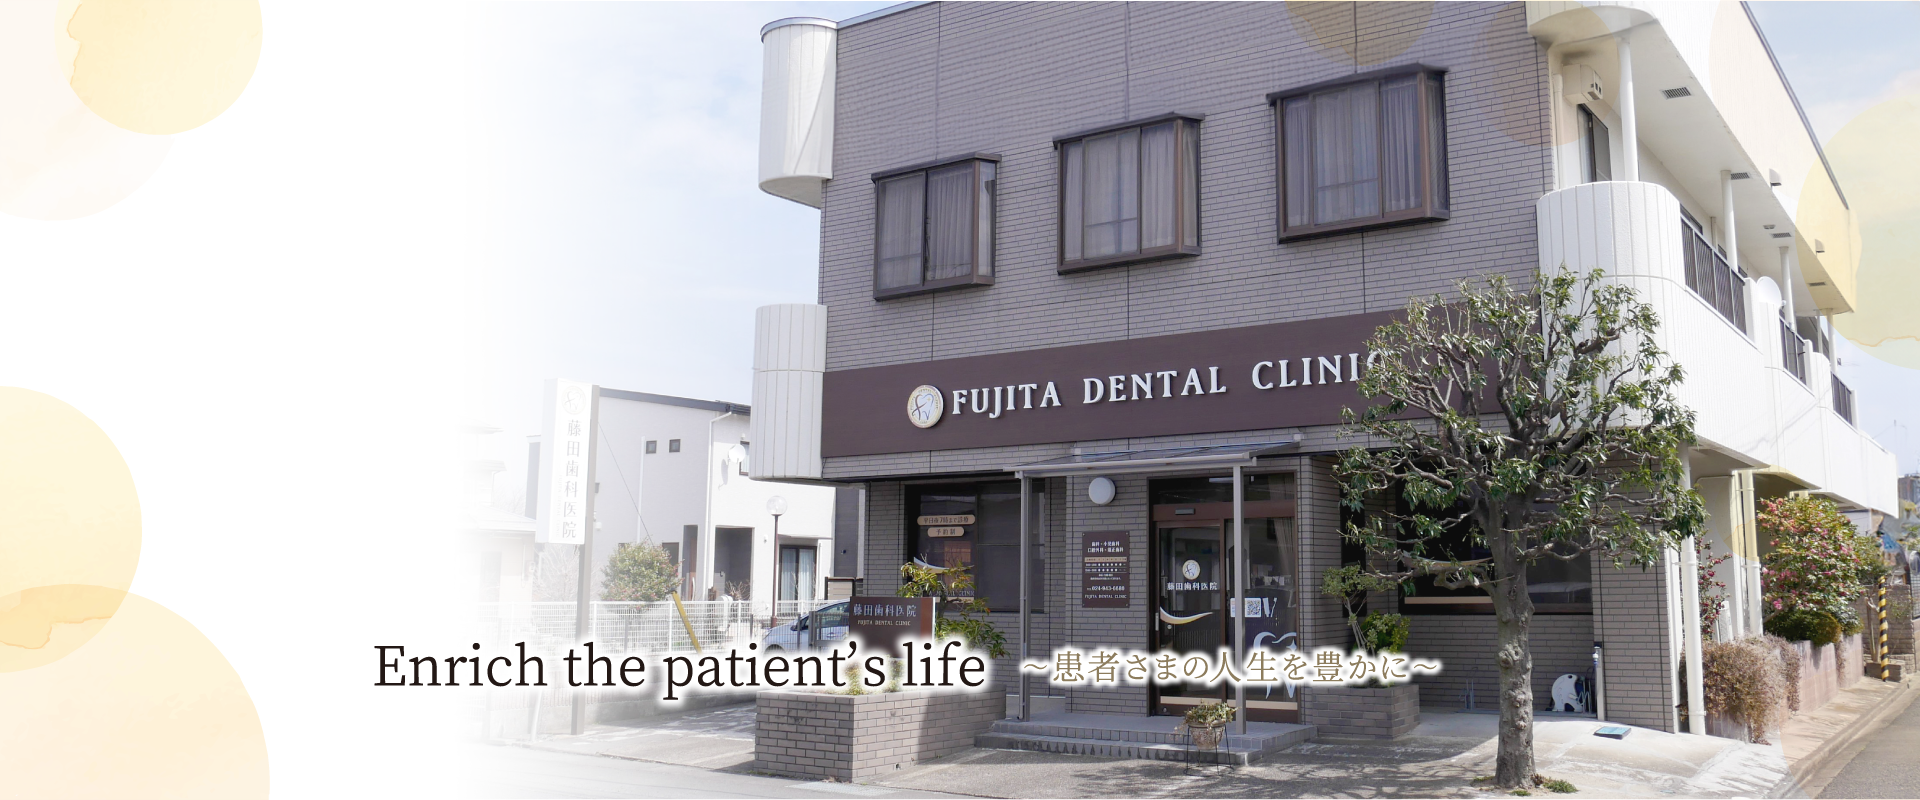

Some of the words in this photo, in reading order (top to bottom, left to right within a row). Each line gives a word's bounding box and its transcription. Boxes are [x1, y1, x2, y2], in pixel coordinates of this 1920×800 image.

[952, 381, 1062, 419] FUJITA
[1082, 366, 1227, 404] DENTAL
[562, 419, 581, 539] 藤田歯科医院
[1166, 582, 1218, 591] 藤田歯科医院
[853, 603, 917, 618] 藤田歯科医院
